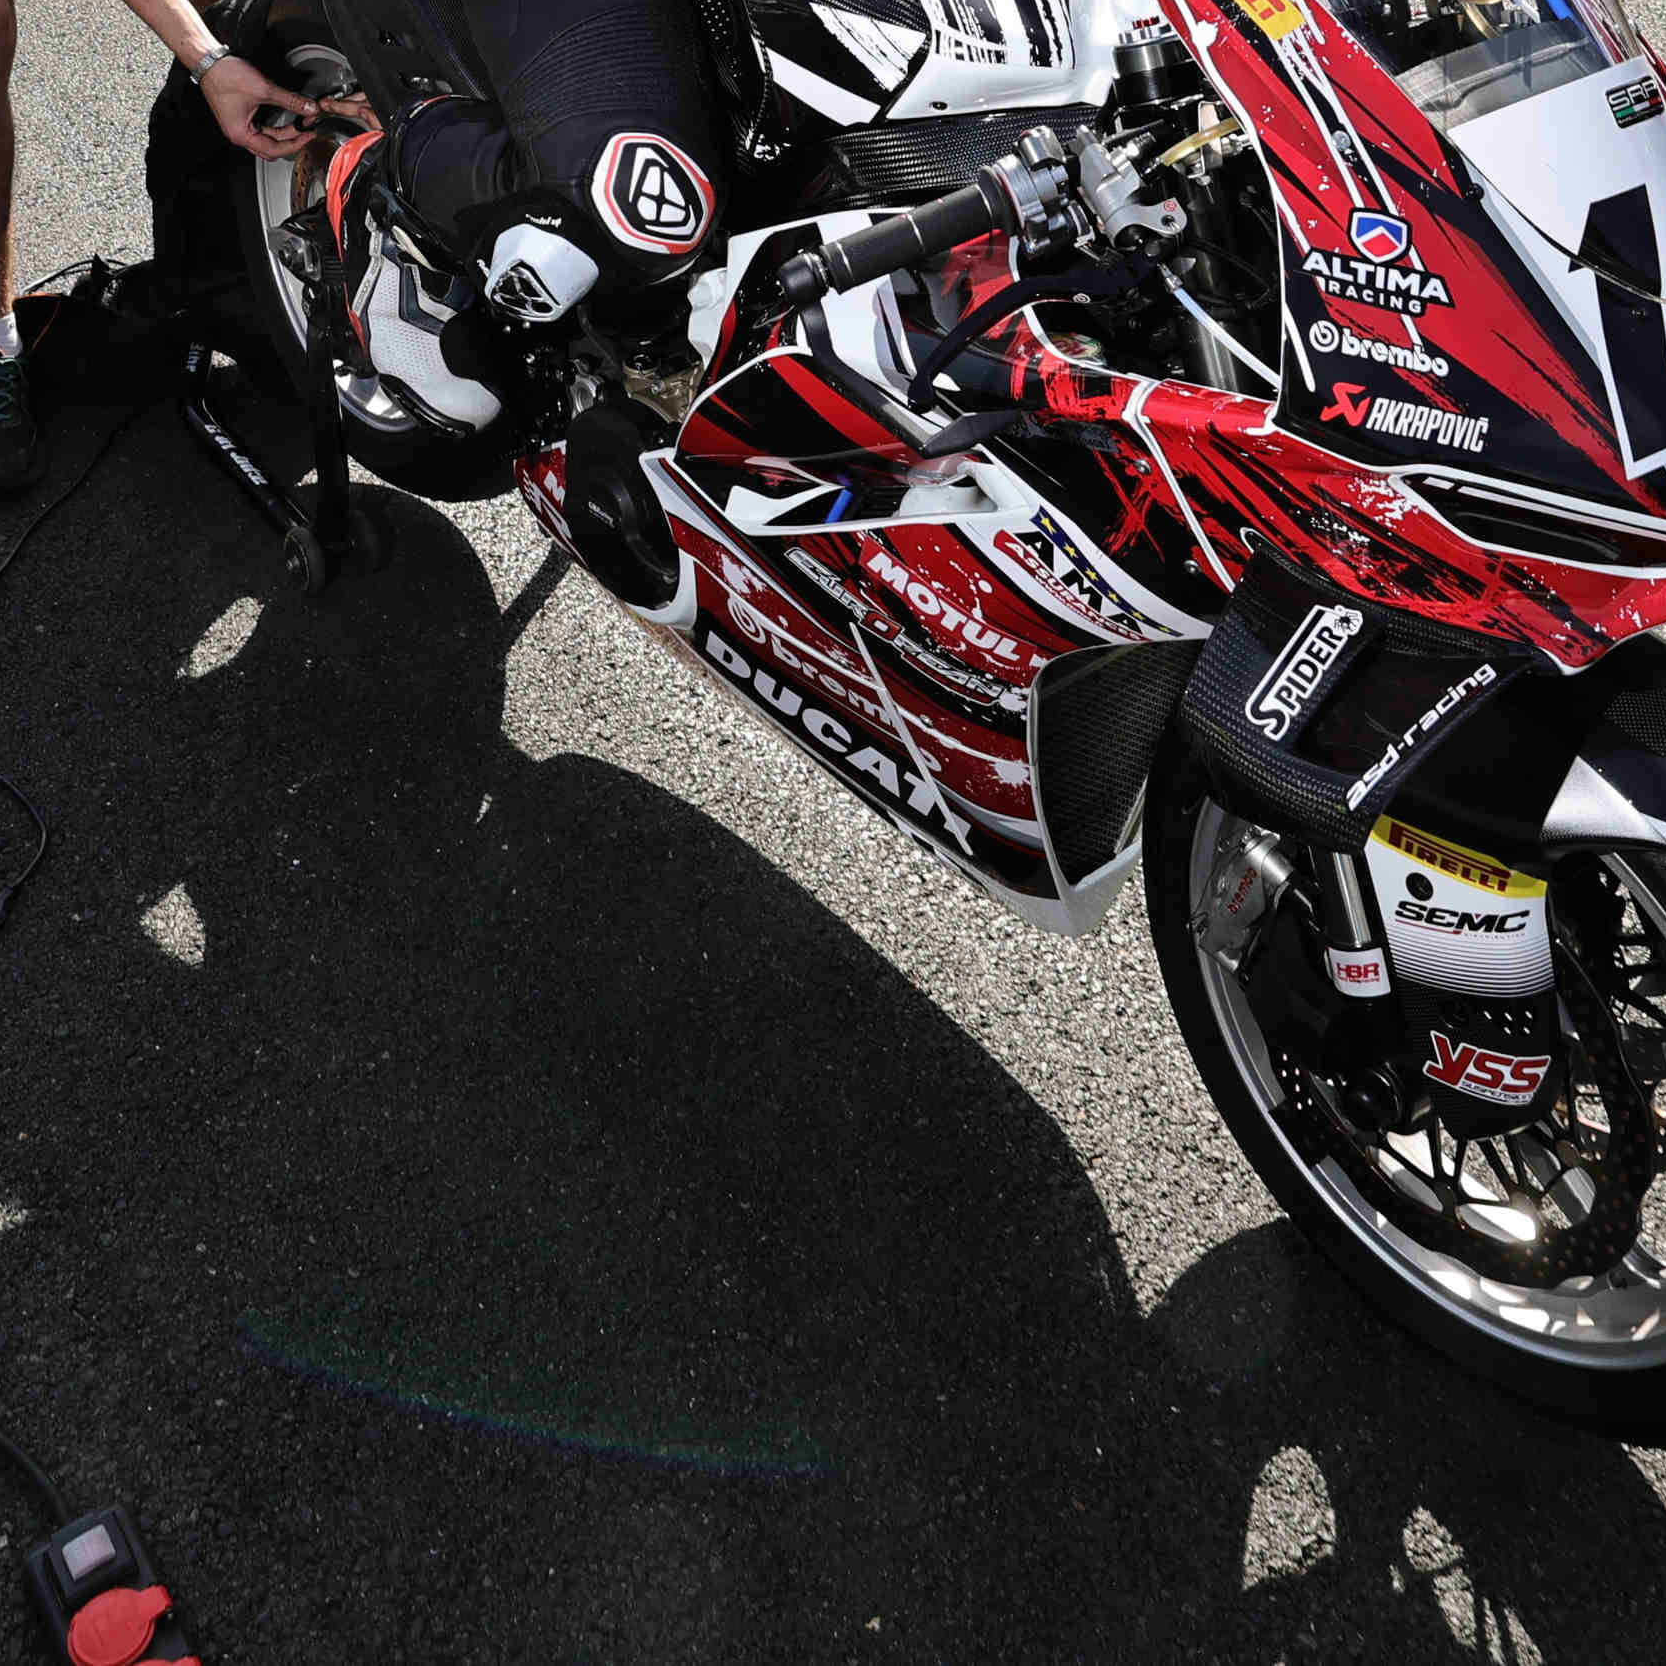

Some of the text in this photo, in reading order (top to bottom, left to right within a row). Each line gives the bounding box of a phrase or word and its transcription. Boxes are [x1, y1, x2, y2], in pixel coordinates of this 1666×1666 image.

[1302, 251, 1450, 304] ALTIMA
[1327, 277, 1423, 314] RACING
[1341, 328, 1450, 377] brembo
[1365, 397, 1490, 453] AKRAPOVIČ
[866, 551, 1024, 662] MOTUL
[1244, 604, 1345, 741] SPIDER
[1345, 662, 1498, 812] asd-racing
[1387, 821, 1513, 893] PIRELLI
[1226, 867, 1258, 916] brembo
[1394, 900, 1531, 934] SEMC
[1335, 962, 1381, 980] HBR
[1424, 1033, 1551, 1094] YSS
